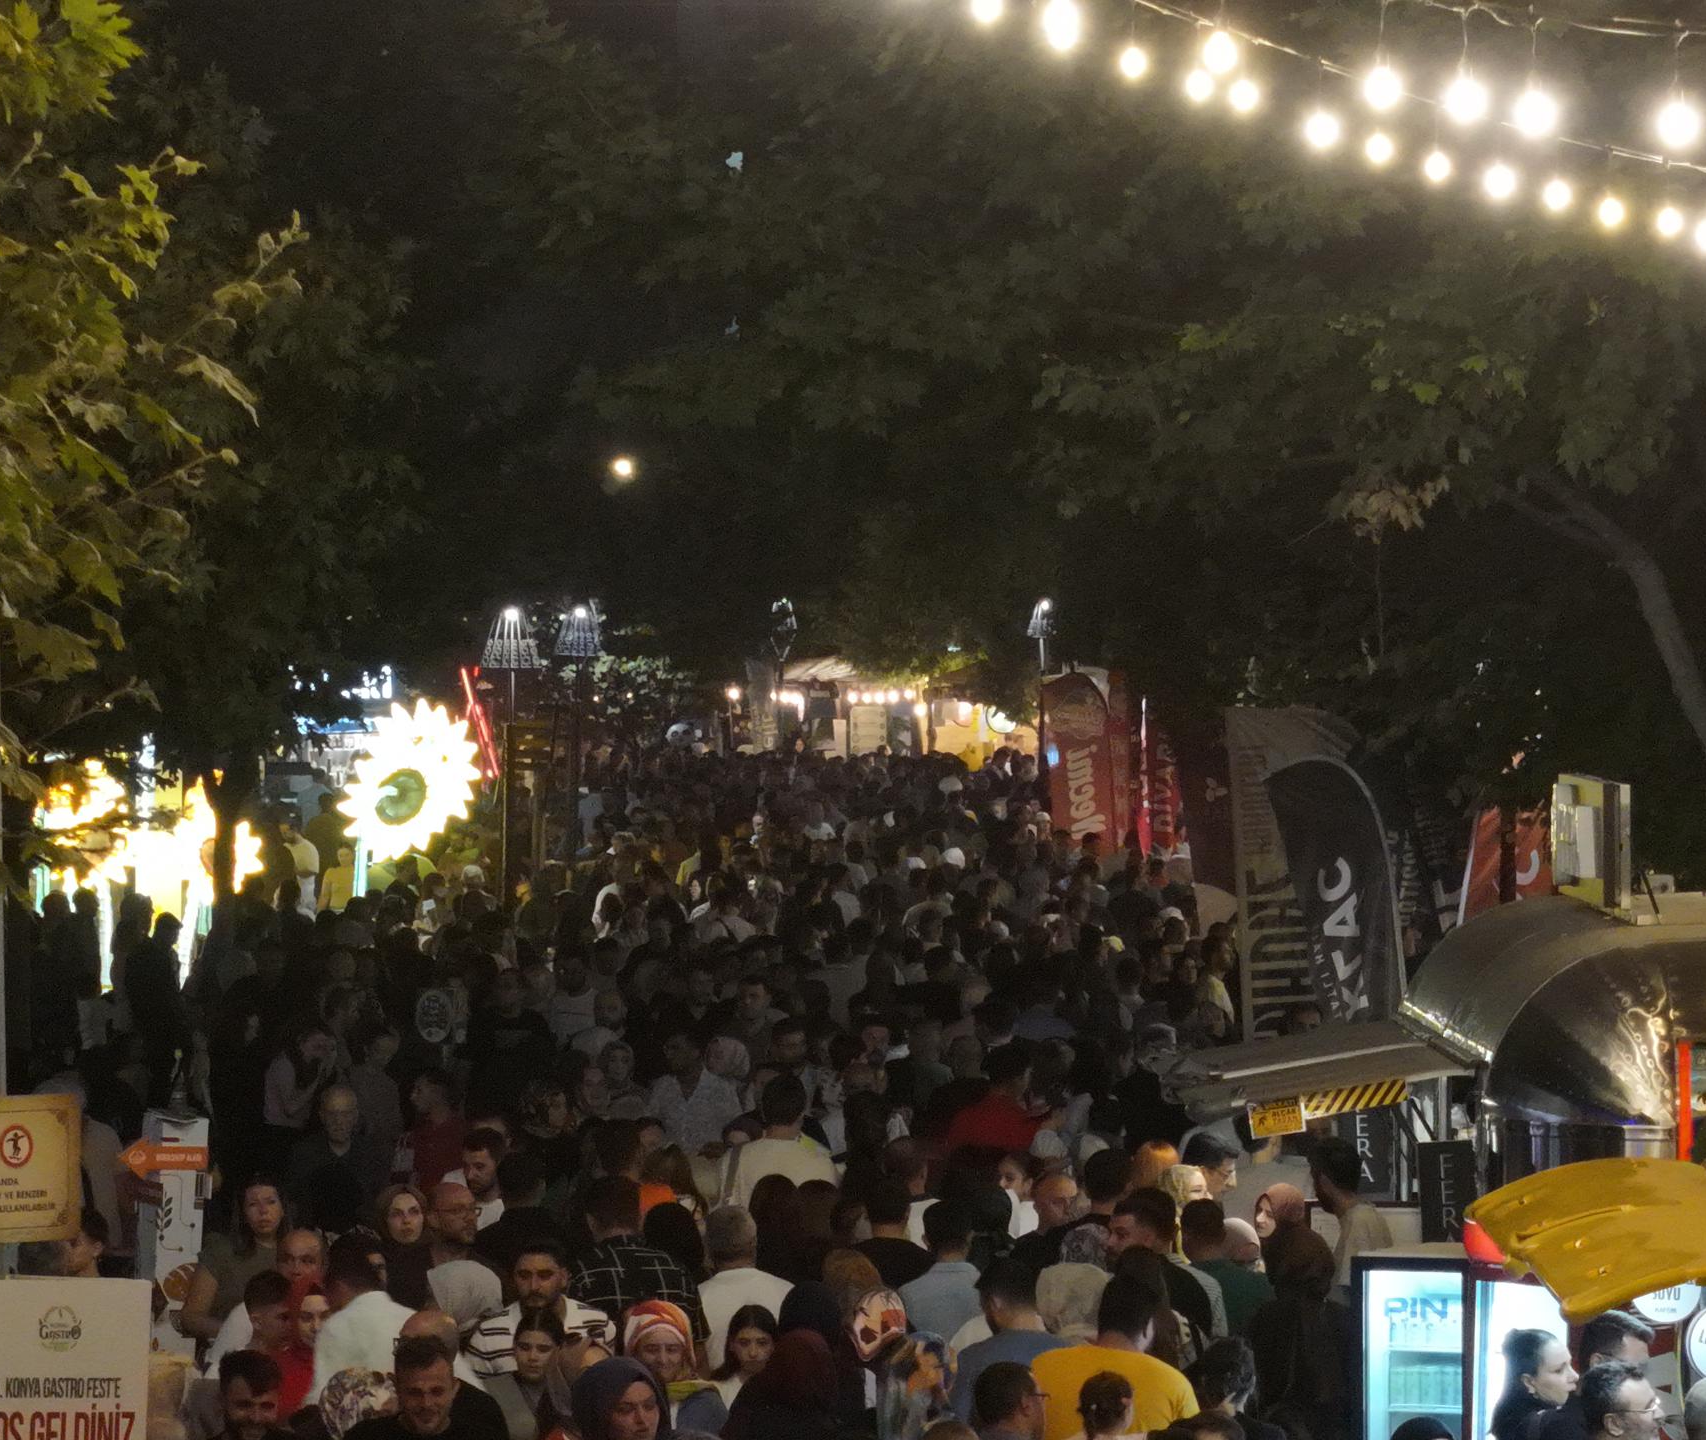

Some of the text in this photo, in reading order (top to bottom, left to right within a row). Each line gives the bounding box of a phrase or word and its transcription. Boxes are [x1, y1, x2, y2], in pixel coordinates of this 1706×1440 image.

[1355, 1110, 1375, 1183] ERA
[6, 1378, 41, 1399] KONYA
[43, 1378, 84, 1399] GASTRO
[86, 1378, 121, 1399] FEST'E
